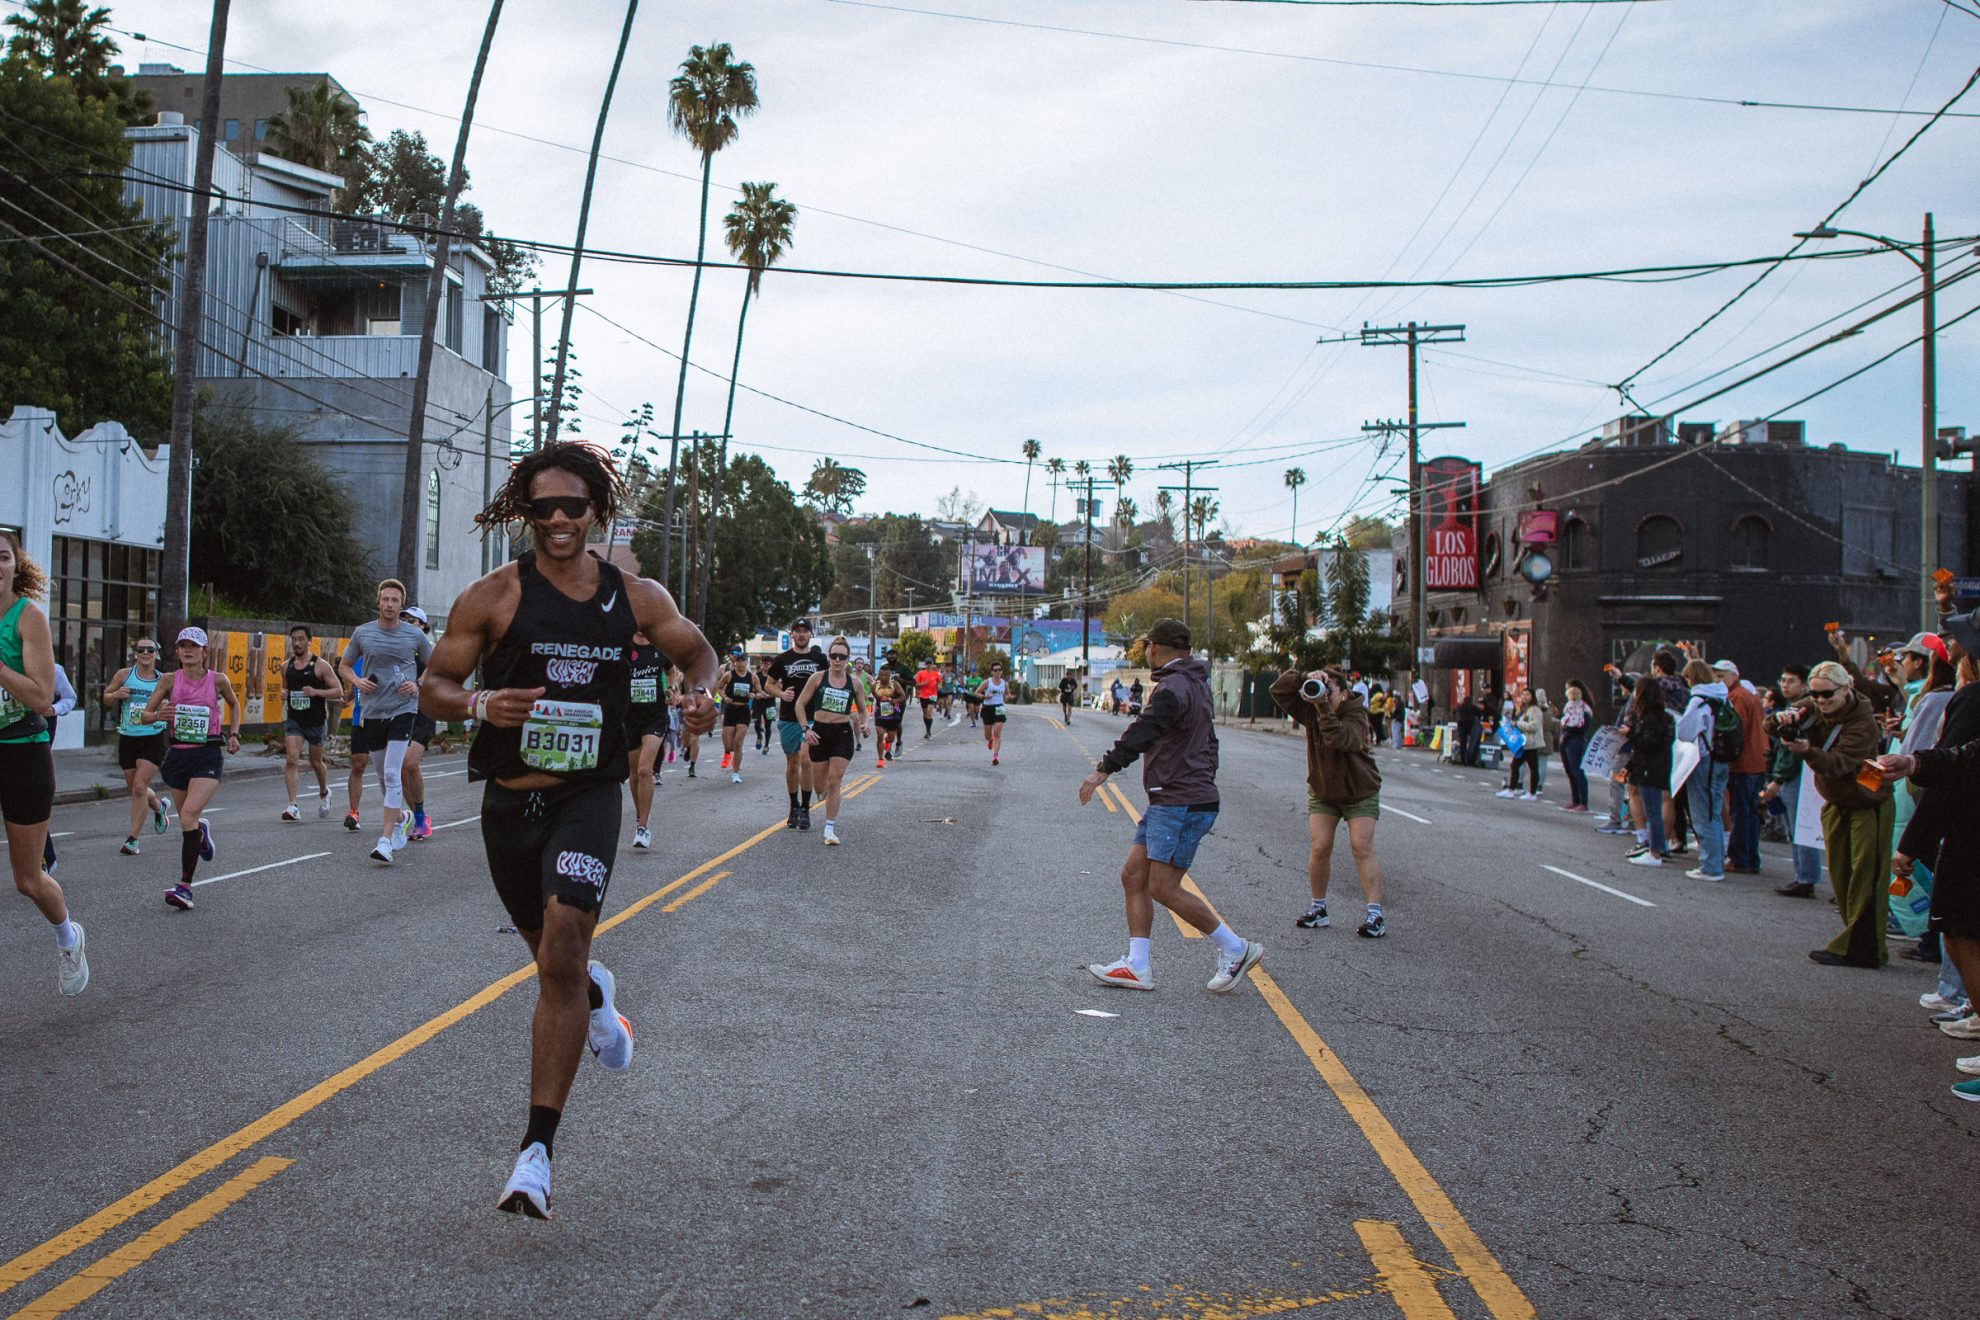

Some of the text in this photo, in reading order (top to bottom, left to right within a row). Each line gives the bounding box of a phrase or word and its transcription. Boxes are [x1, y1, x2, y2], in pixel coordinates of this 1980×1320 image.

[1435, 530, 1466, 555] LOS
[1426, 555, 1475, 585] GLOBOS
[938, 613, 986, 626] TROPAL
[531, 642, 622, 661] RENEGADE
[229, 655, 243, 673] UGG
[268, 656, 281, 674] UGG
[787, 663, 818, 674] EAGLES
[176, 717, 207, 729] 12358
[527, 730, 594, 754] B3031
